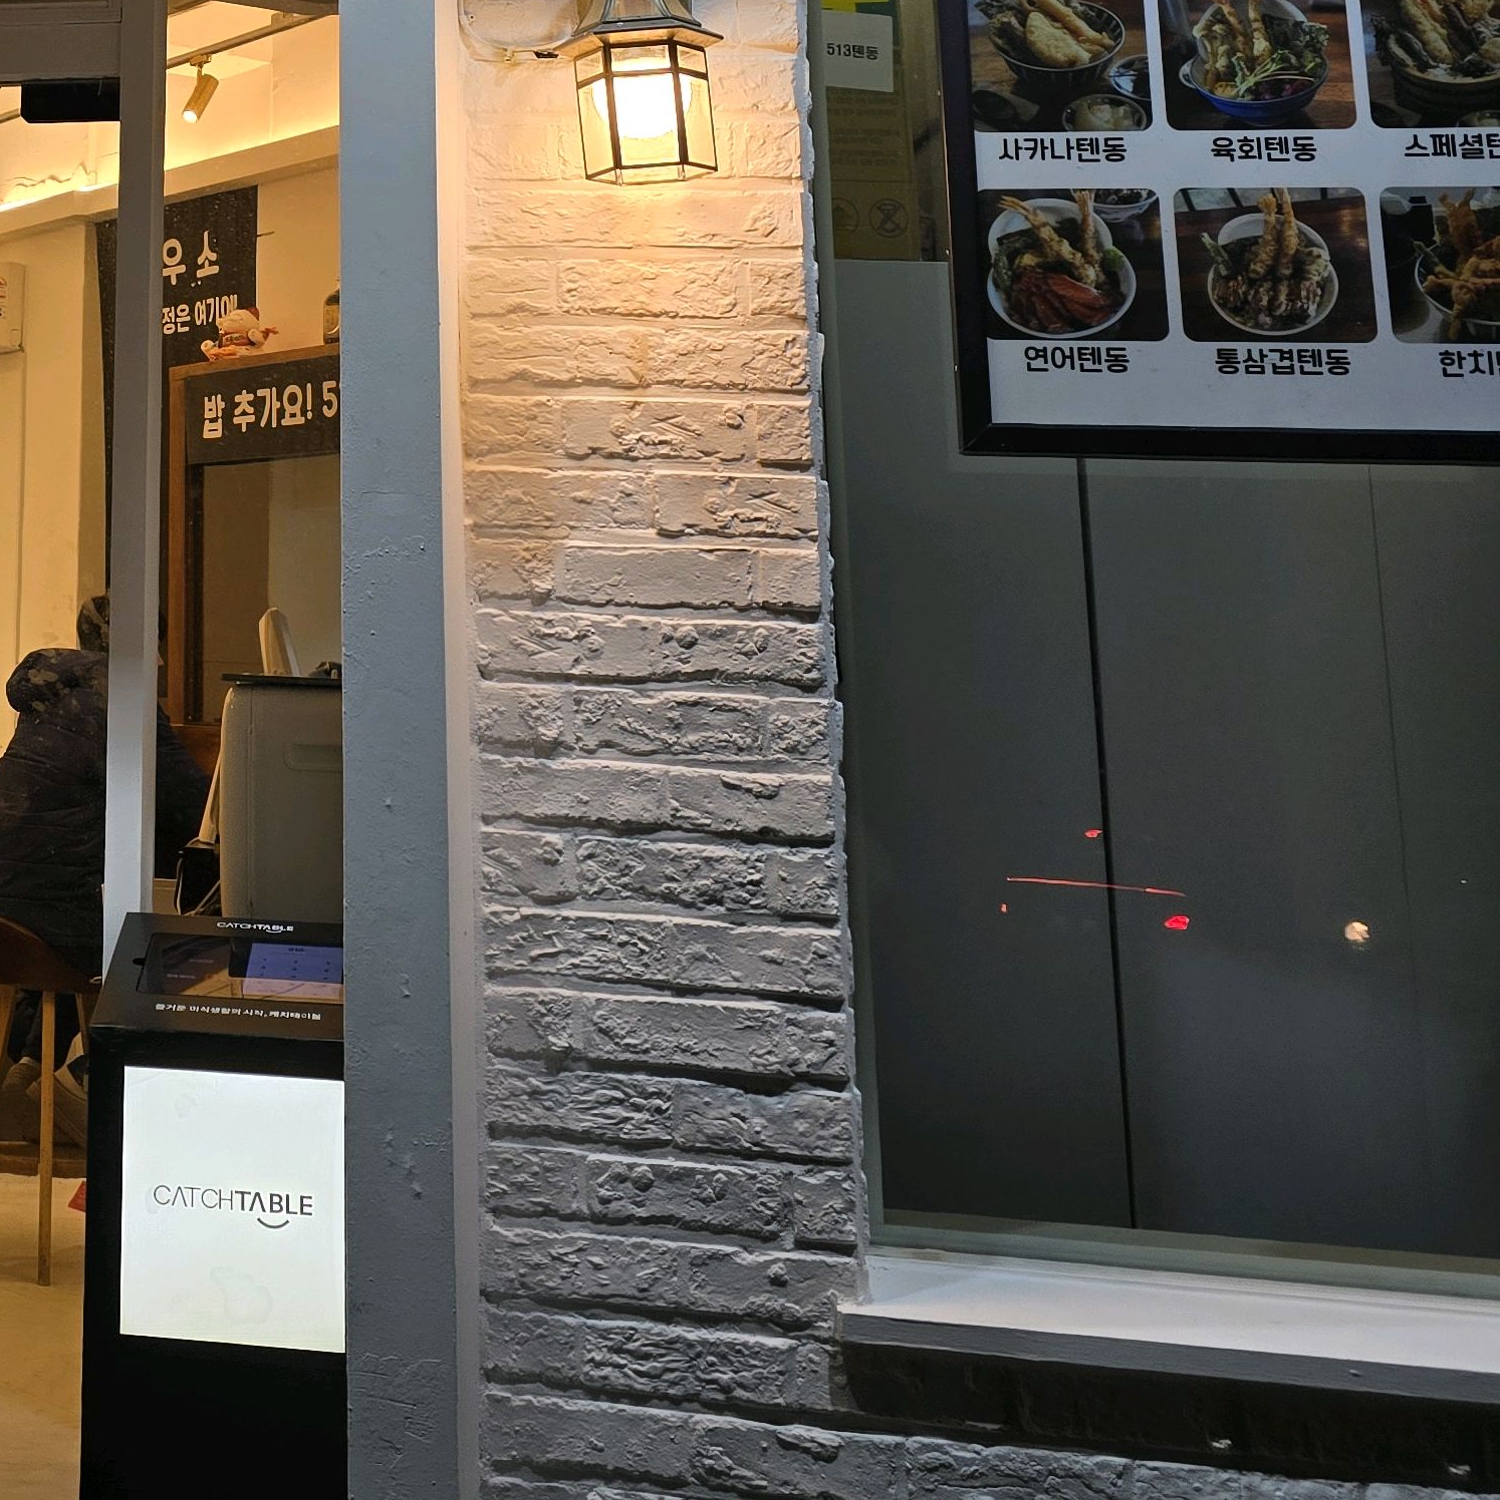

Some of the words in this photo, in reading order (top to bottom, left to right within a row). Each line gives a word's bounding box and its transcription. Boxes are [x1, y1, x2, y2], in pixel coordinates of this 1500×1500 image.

[998, 136, 1128, 162] 사카나텐동
[1210, 135, 1317, 162] 육회텐동
[1024, 345, 1131, 373] 연어텐동
[1215, 347, 1352, 376] 통삼겹텐동
[1438, 349, 1500, 378] 한치
[202, 393, 226, 439] 밥
[232, 382, 313, 433] 추가요!
[322, 379, 340, 418] 5
[216, 921, 295, 933] CATCHTABLE
[153, 1184, 314, 1217] CATCHTABLE
